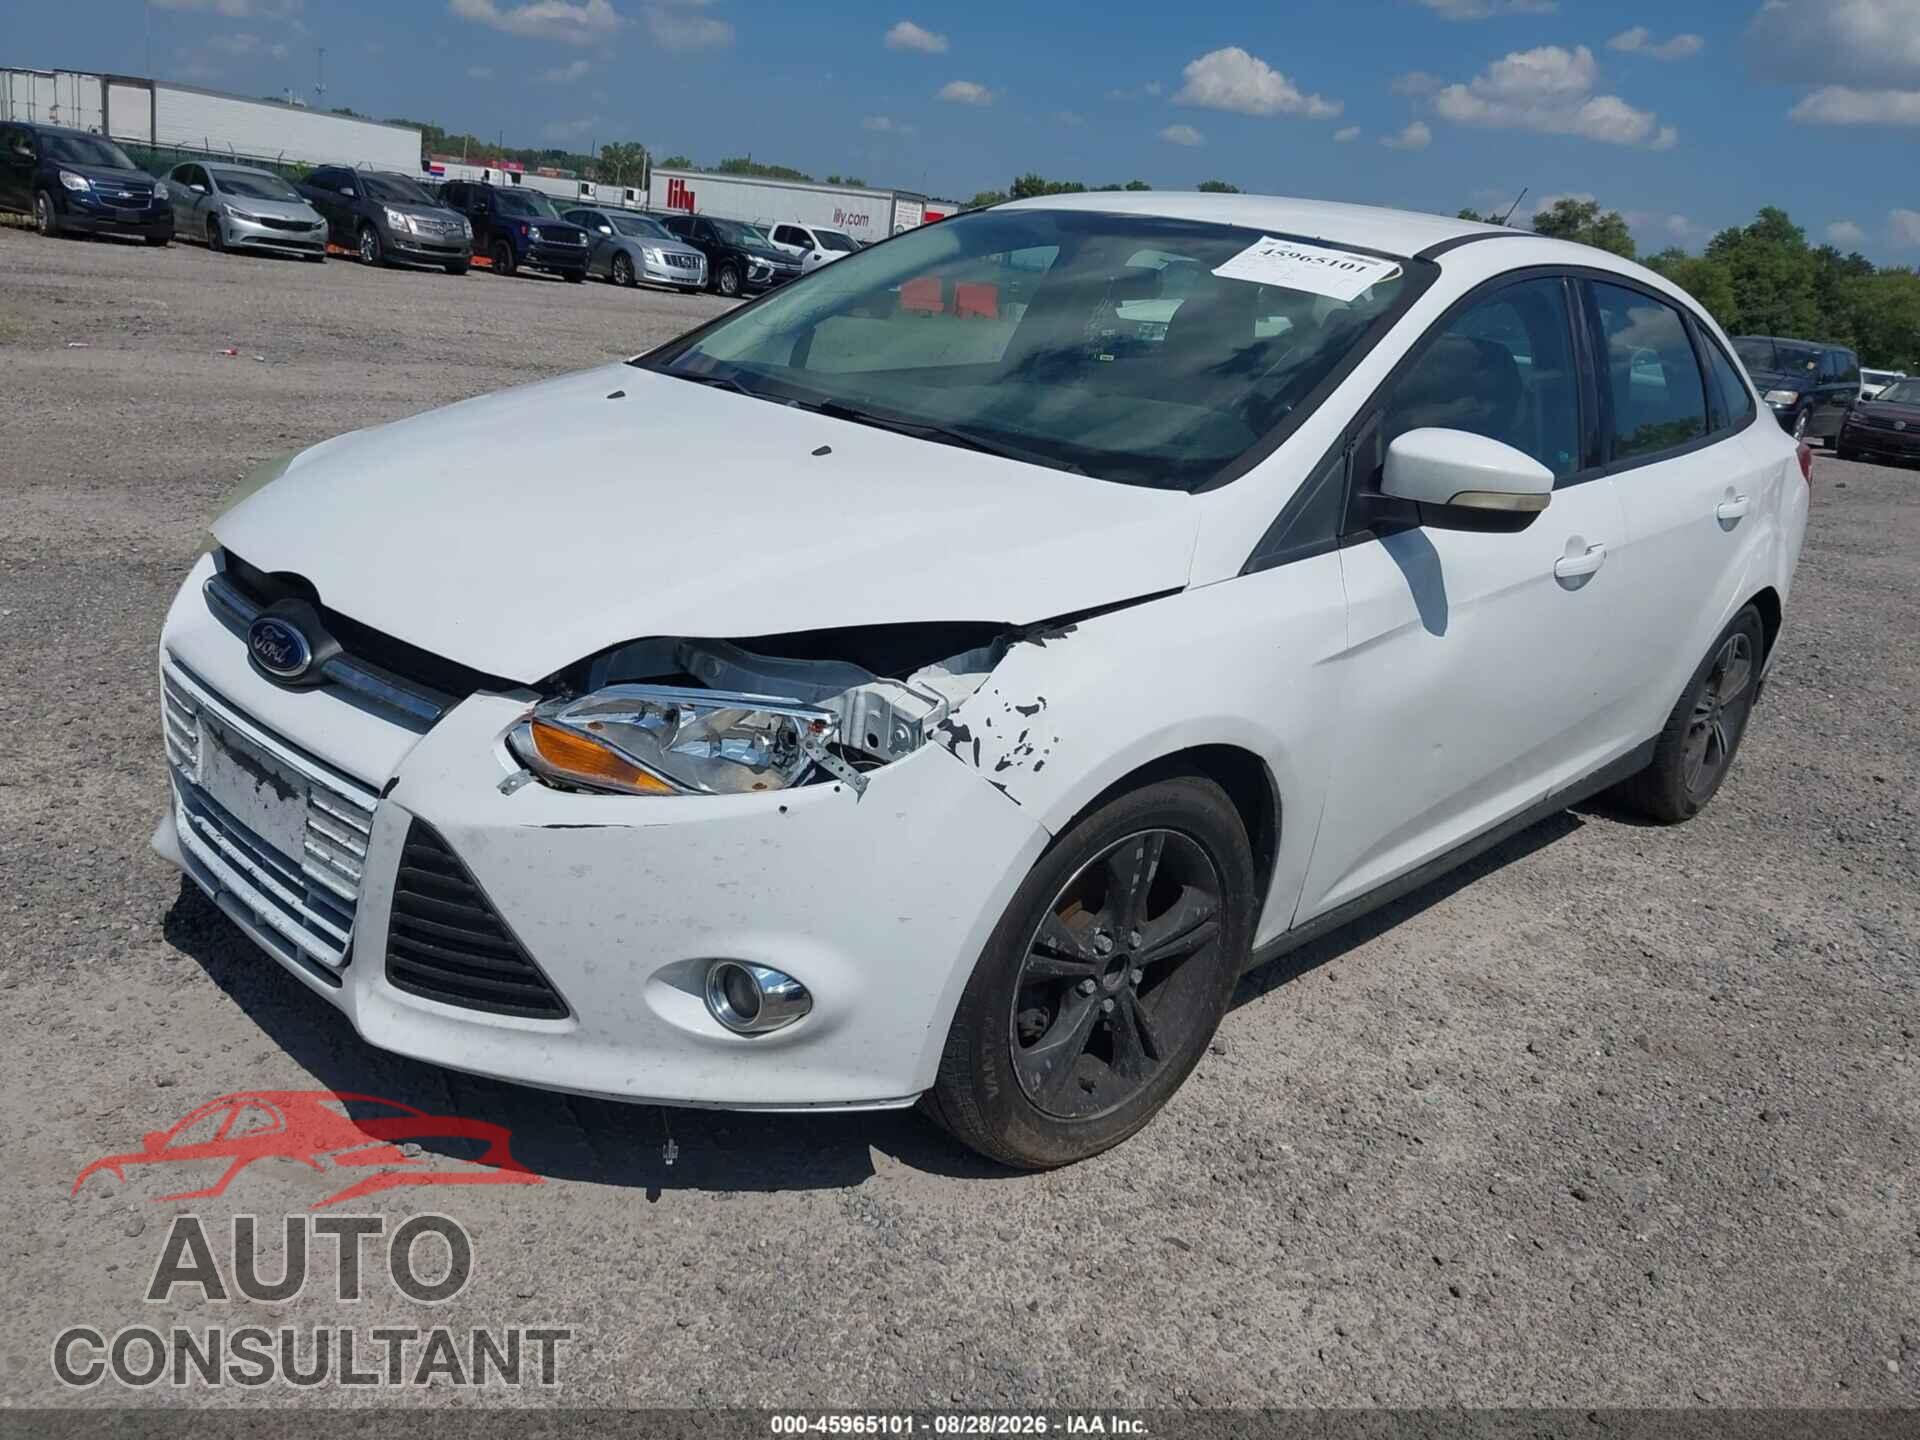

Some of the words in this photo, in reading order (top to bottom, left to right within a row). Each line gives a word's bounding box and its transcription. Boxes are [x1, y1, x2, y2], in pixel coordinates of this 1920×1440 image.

[667, 178, 695, 214] lily
[833, 208, 869, 227] lily.com
[254, 625, 291, 663] Ford
